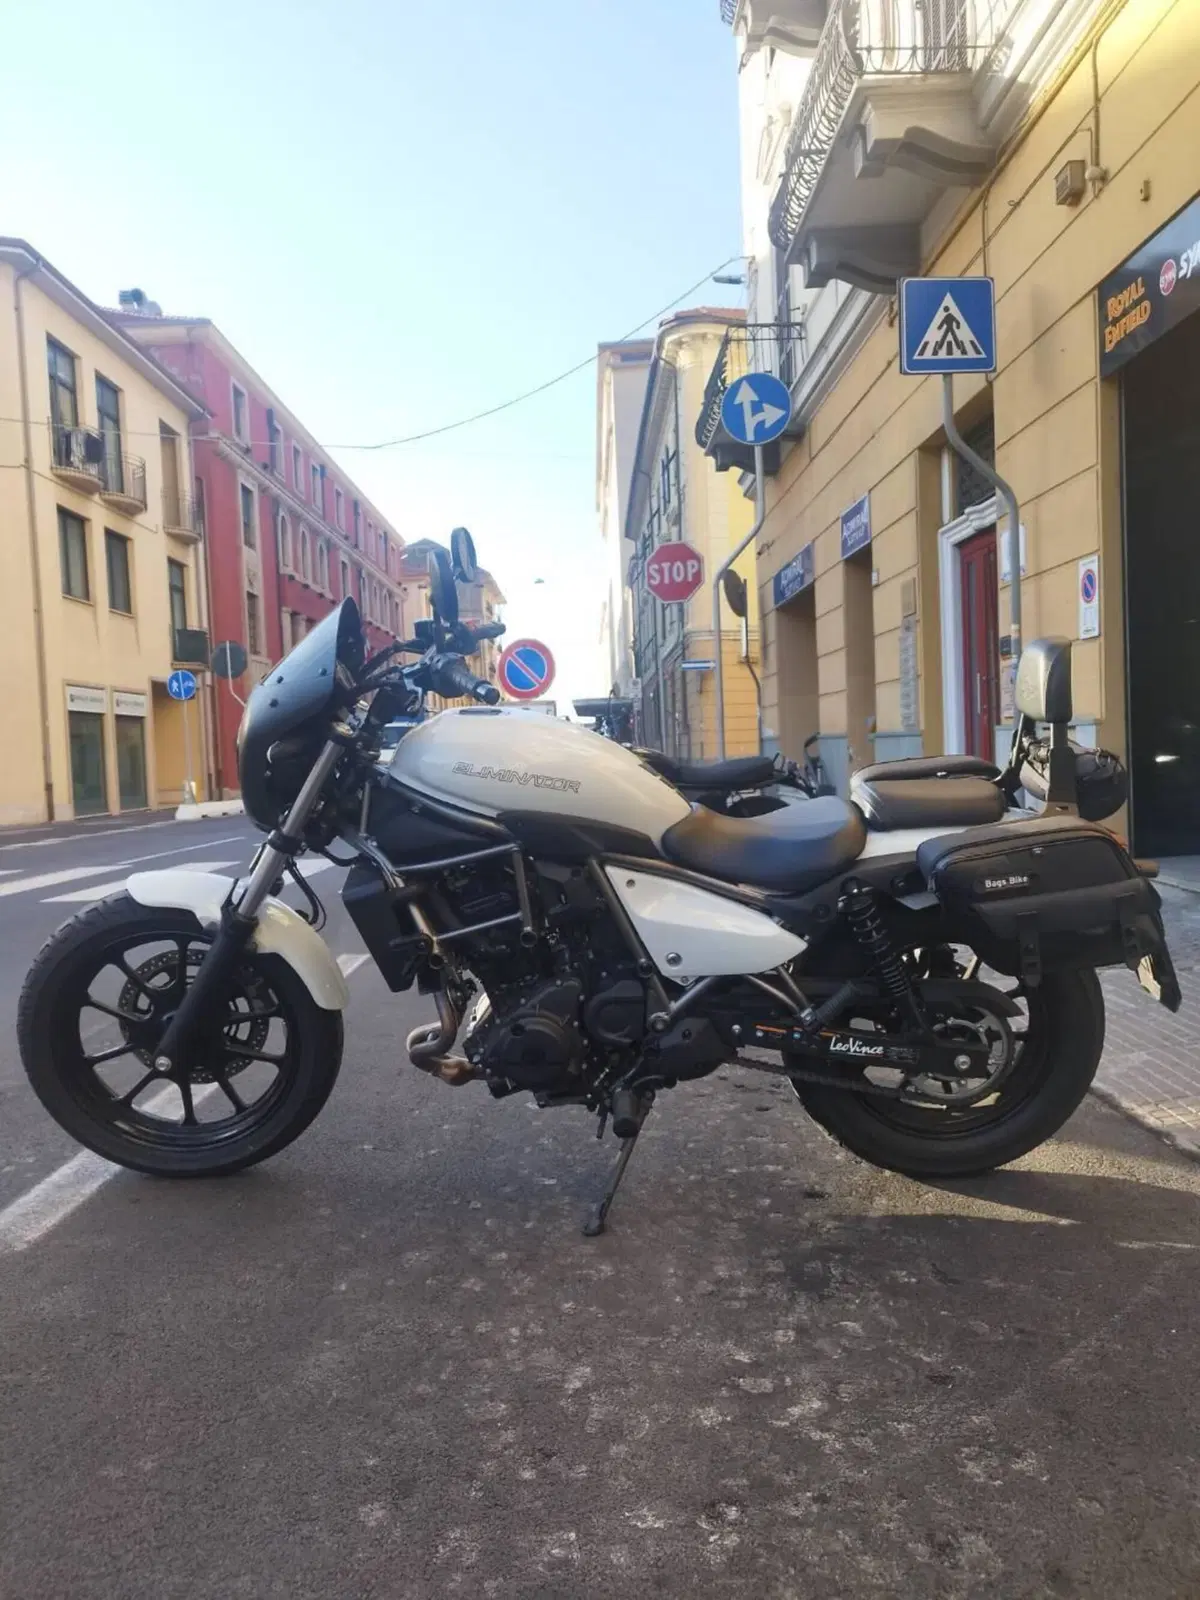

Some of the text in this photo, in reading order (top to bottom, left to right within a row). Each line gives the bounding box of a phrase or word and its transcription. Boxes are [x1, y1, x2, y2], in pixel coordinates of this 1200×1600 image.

[1107, 276, 1146, 322] ROYAL
[1104, 299, 1151, 353] ENFIELD
[649, 559, 699, 585] STOP
[451, 761, 581, 793] ELIMINATOR
[985, 875, 1029, 888] Bags Bike
[830, 1035, 884, 1055] LeoVince
